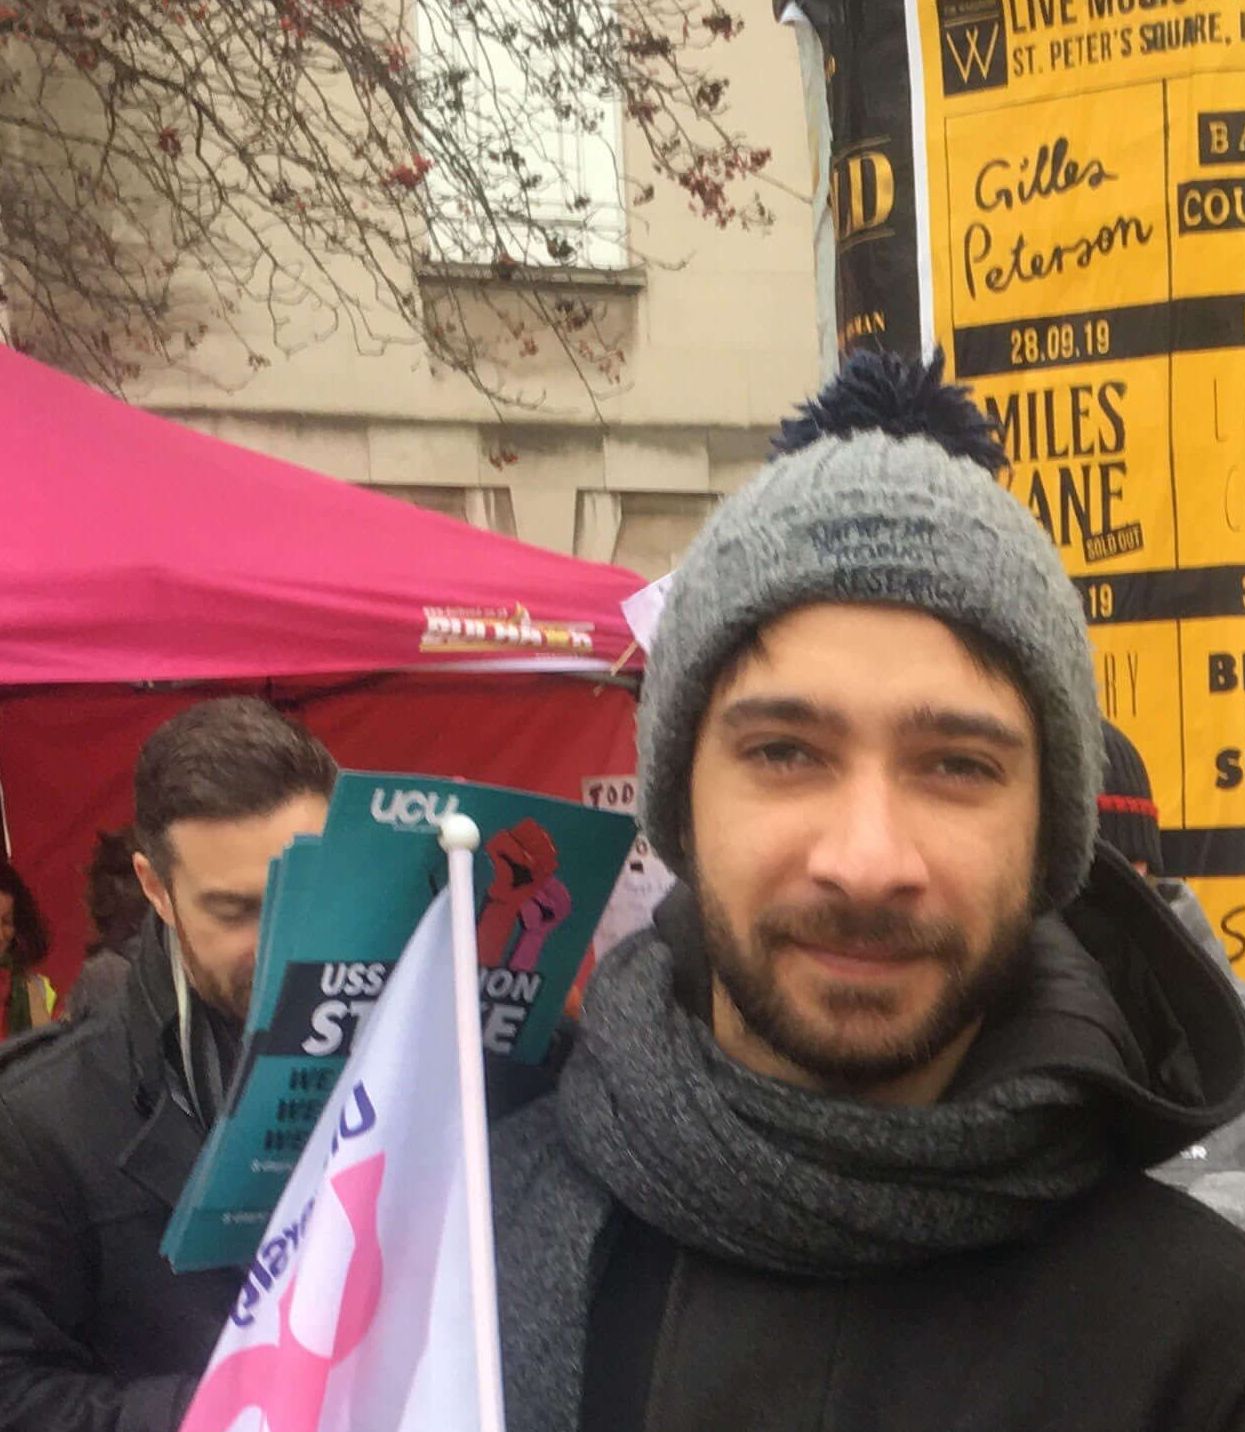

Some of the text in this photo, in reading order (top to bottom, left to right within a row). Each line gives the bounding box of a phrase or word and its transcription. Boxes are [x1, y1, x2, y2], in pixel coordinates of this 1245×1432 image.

[1012, 46, 1044, 79] ST.
[1050, 28, 1133, 71] PETER'S
[1140, 11, 1232, 54] SQUARE,
[975, 136, 1119, 214] Gilles
[963, 215, 1154, 301] Peterson
[1010, 319, 1112, 367] 28.09.19
[983, 379, 1128, 465] MILES
[1027, 461, 1128, 548] ANE
[371, 786, 460, 826] UCU
[320, 961, 387, 998] USS
